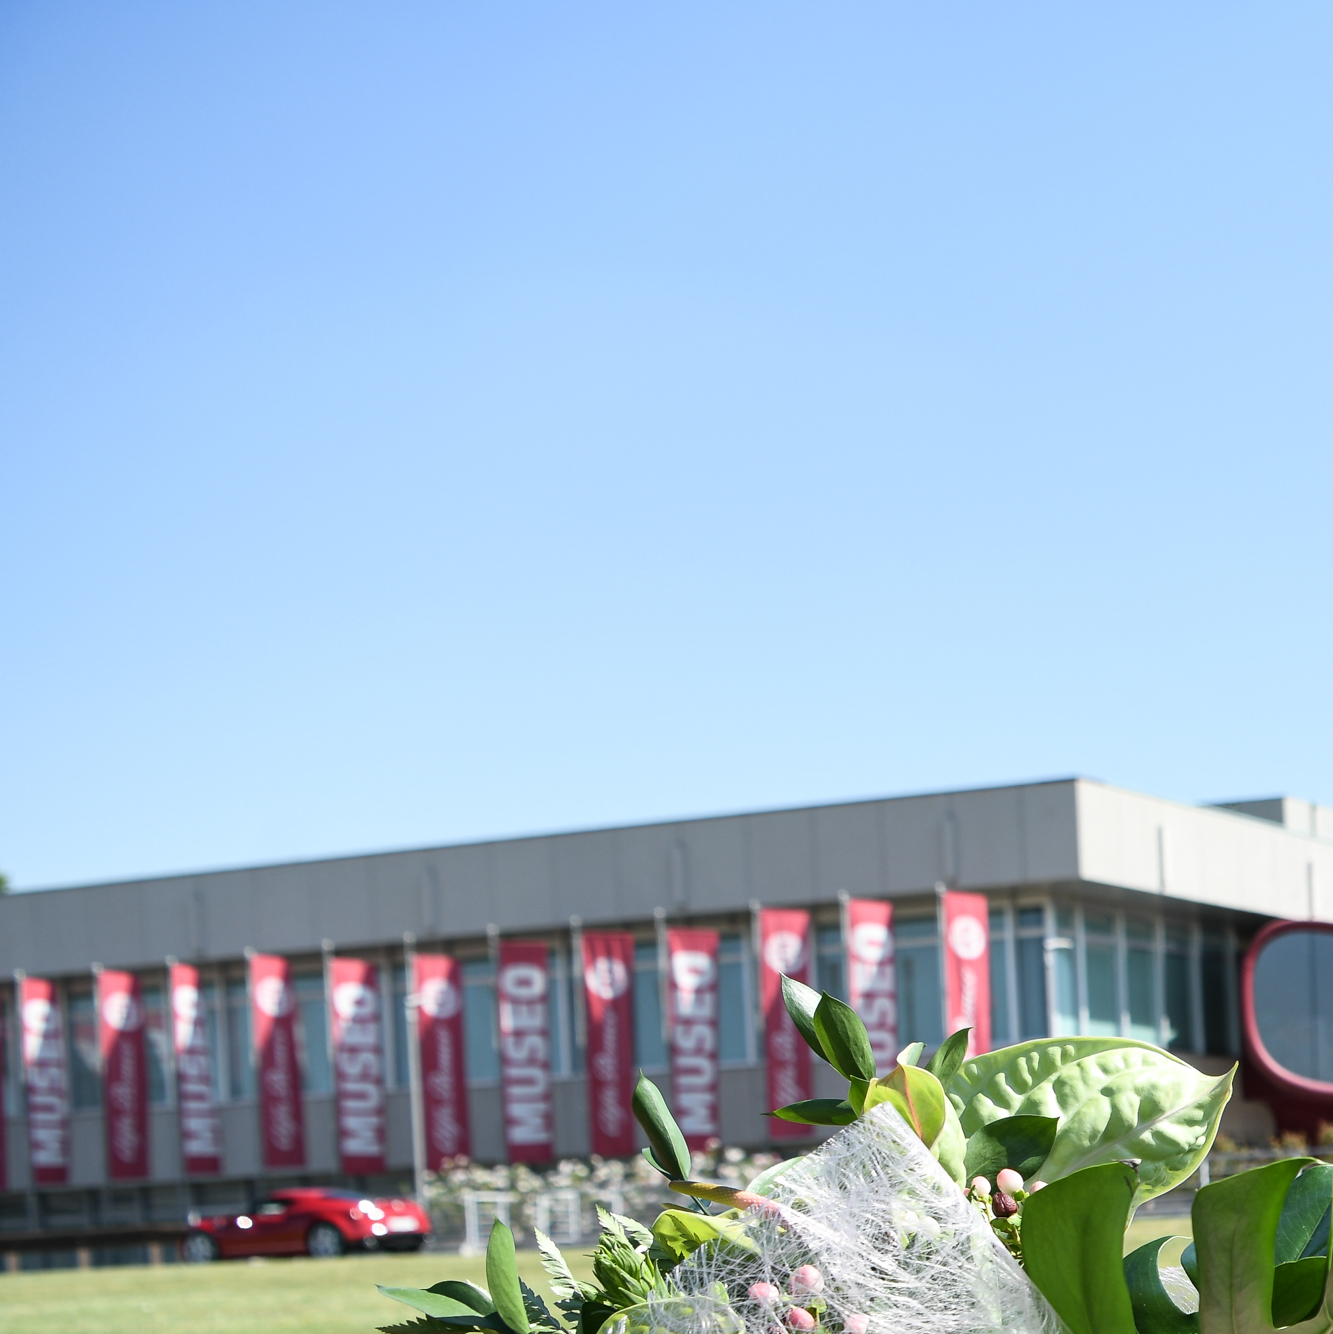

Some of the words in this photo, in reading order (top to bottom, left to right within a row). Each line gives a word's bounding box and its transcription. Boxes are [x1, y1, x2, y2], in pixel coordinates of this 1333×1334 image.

[23, 997, 66, 1167] MUSEO
[333, 981, 382, 1155] MUSEO
[501, 963, 549, 1144] MUSEO
[671, 952, 717, 1135] MUSEO
